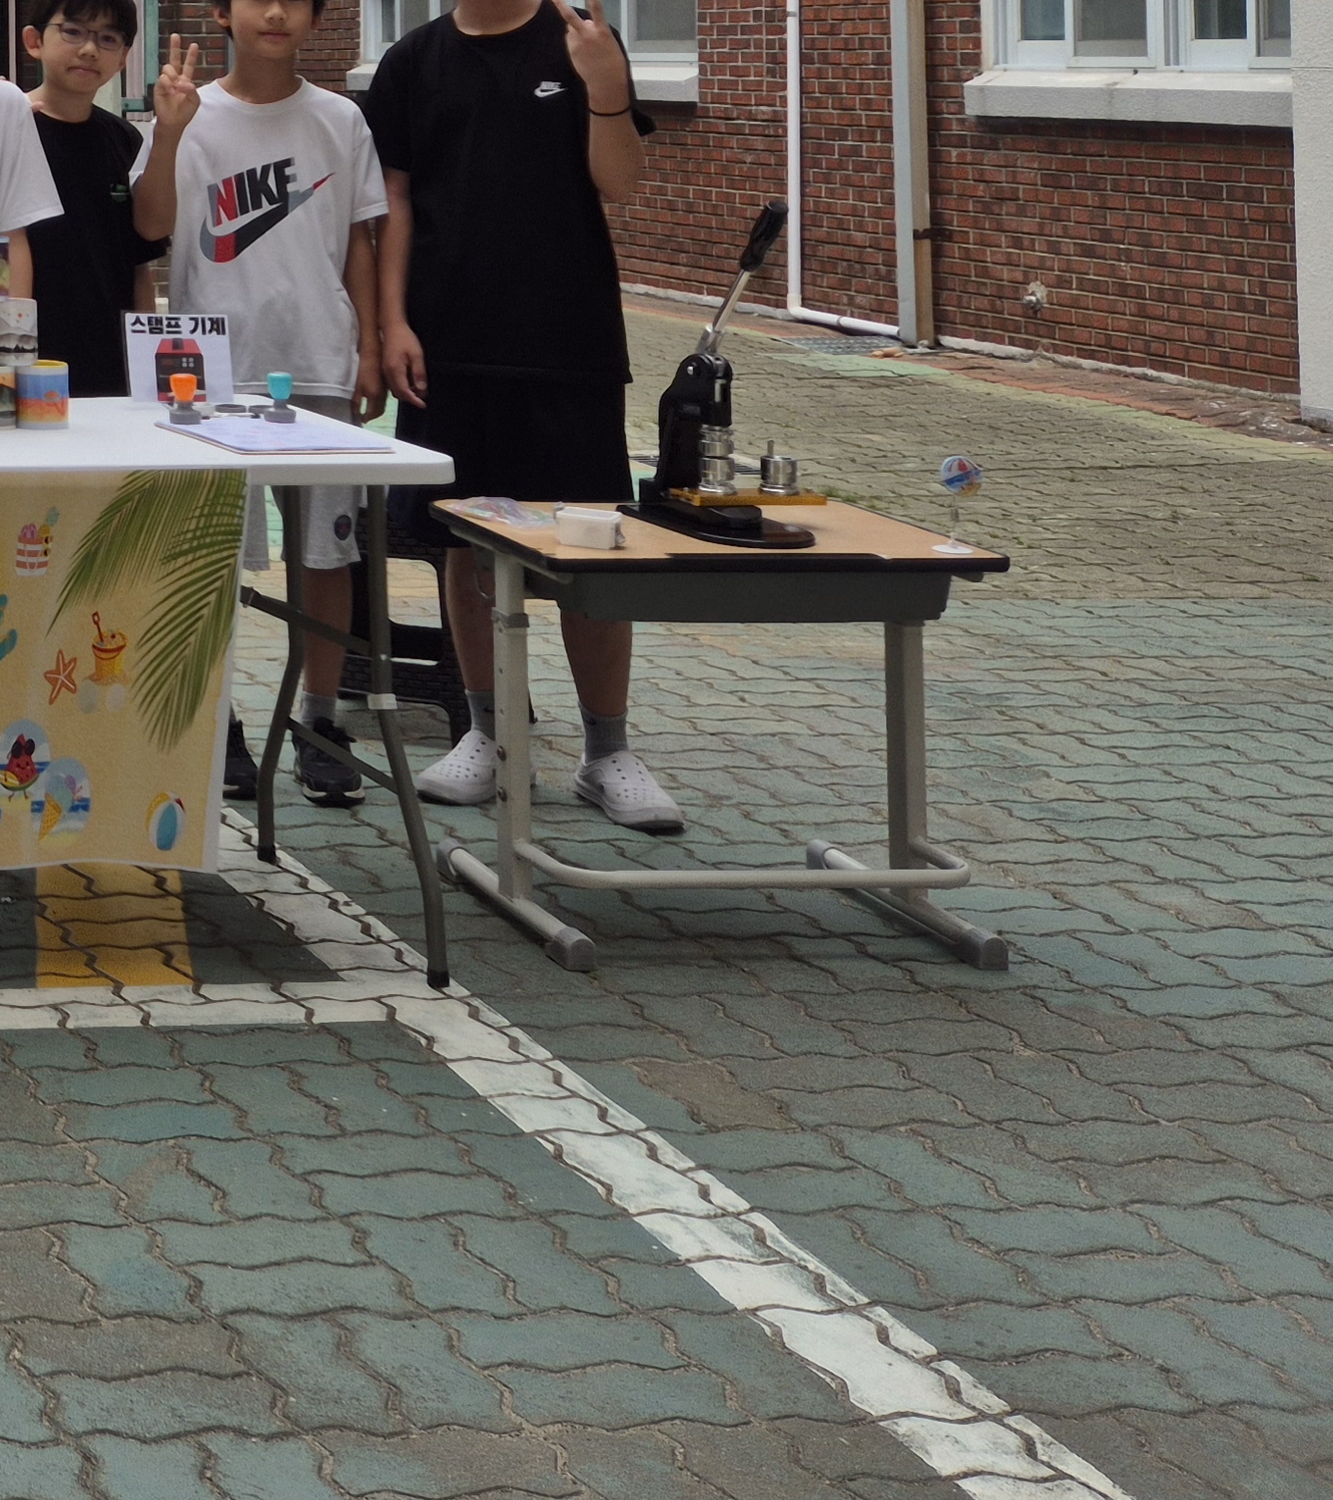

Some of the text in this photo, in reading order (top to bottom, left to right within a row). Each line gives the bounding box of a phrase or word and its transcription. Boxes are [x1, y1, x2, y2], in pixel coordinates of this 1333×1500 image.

[207, 157, 301, 227] NIKE
[130, 316, 226, 336] 스탬프 기계
